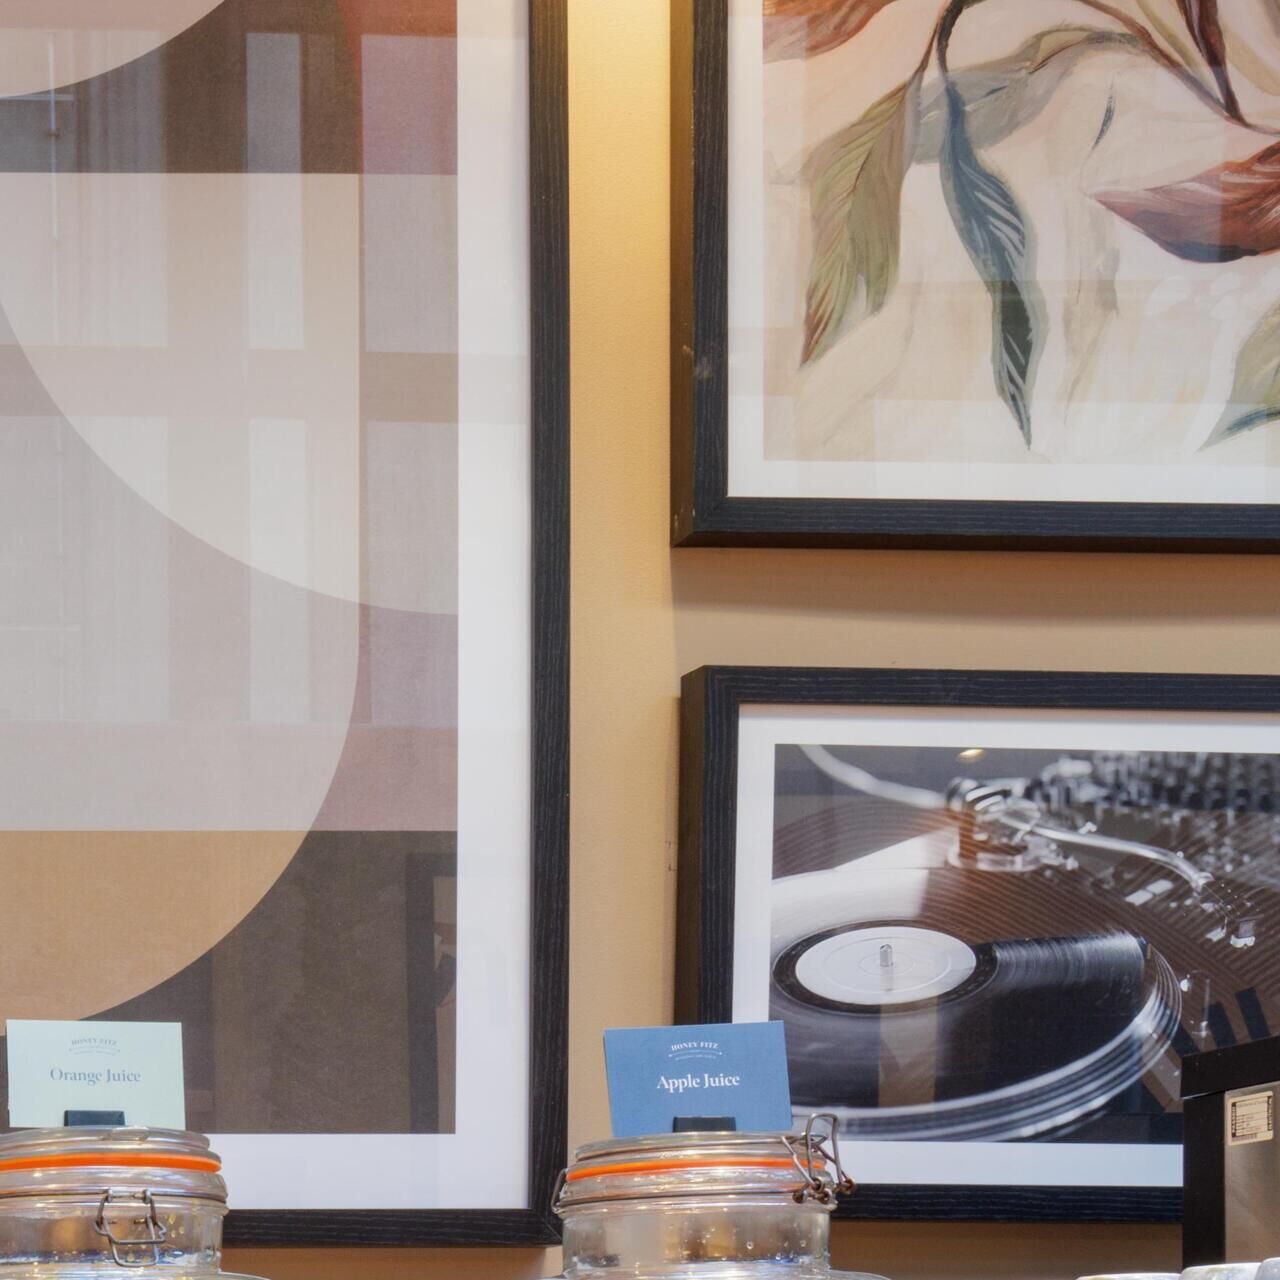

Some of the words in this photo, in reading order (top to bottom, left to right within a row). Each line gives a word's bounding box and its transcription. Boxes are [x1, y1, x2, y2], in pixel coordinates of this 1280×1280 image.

[671, 1041, 698, 1051] HONEY
[700, 1040, 719, 1049] FITZ
[49, 1067, 103, 1086] Orange
[105, 1068, 142, 1083] Juice
[656, 1073, 701, 1093] Apple
[703, 1072, 740, 1088] Juice
